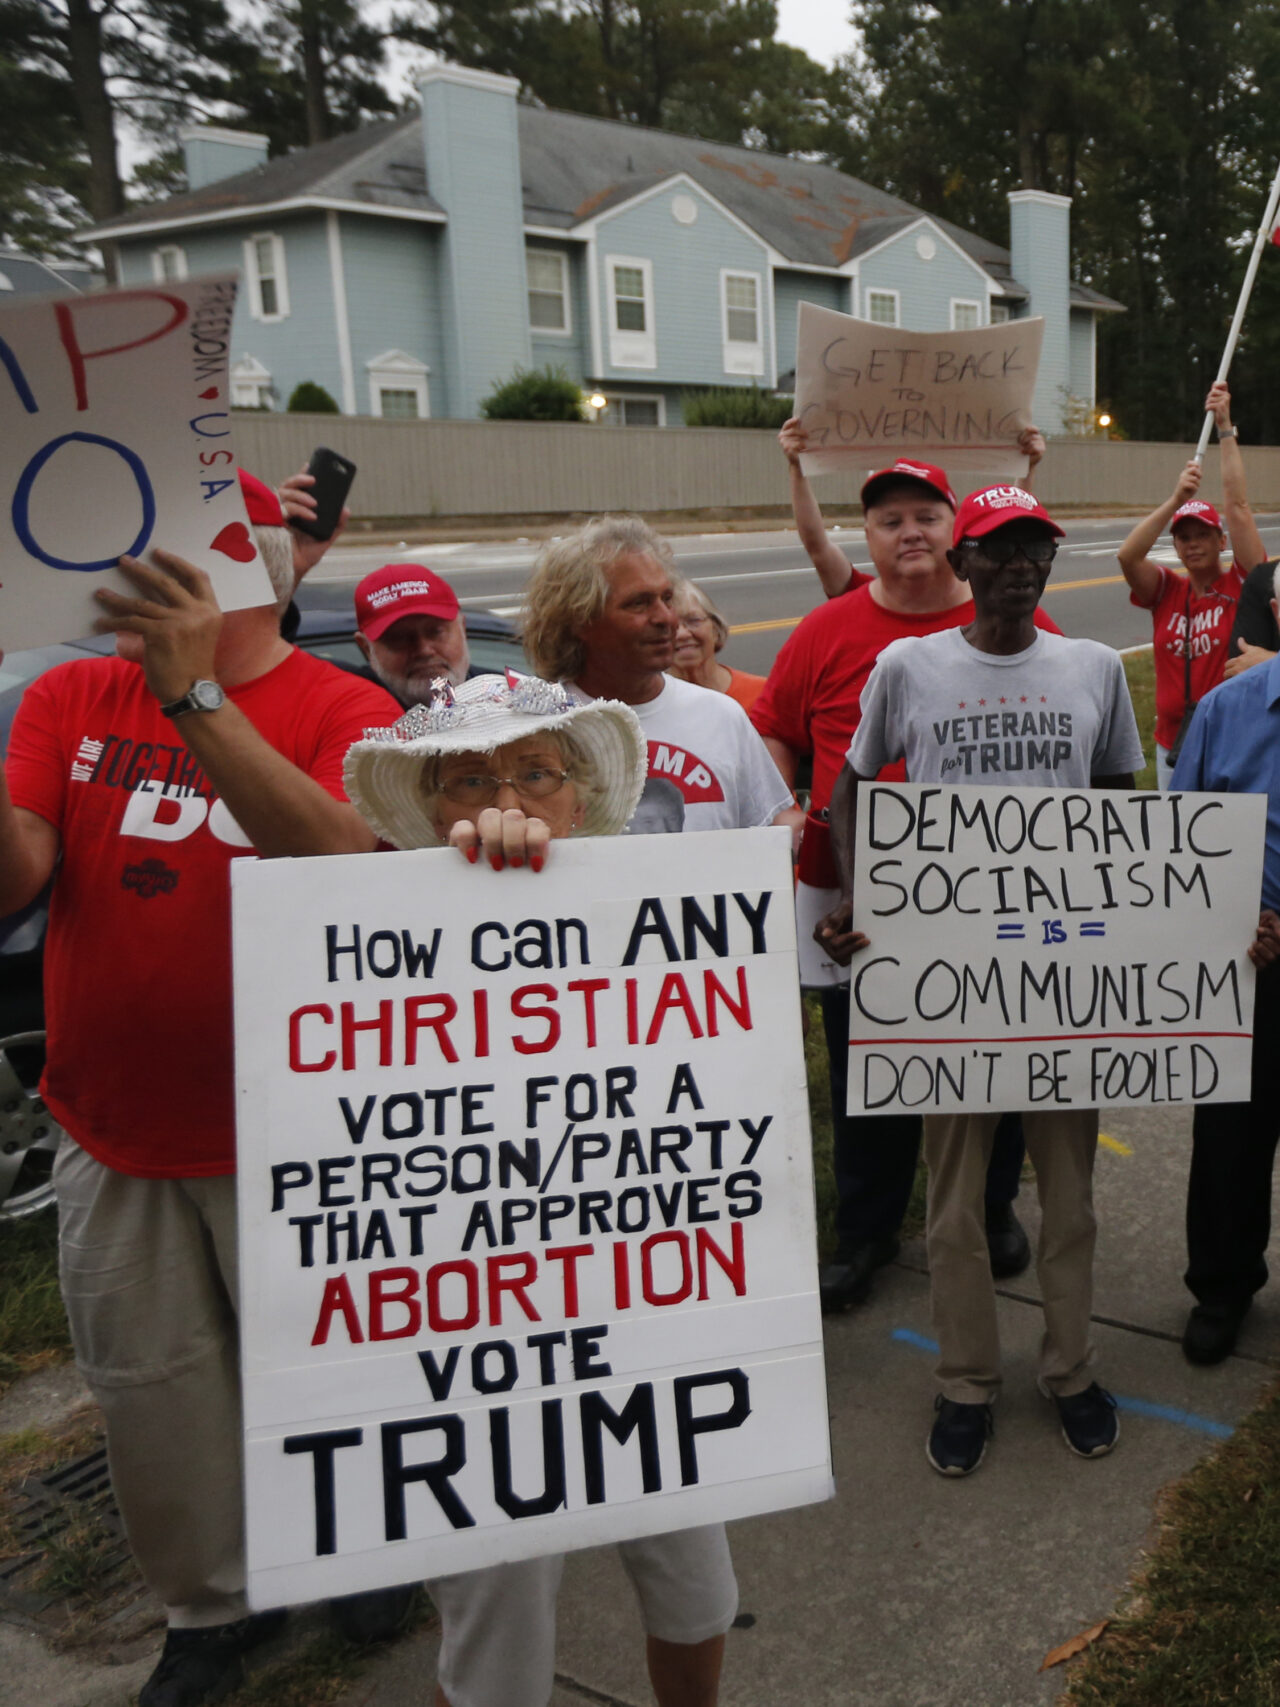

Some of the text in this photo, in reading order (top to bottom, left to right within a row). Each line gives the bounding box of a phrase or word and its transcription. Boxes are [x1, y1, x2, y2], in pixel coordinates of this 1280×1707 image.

[822, 337, 1025, 387] GET BACK
[892, 387, 926, 401] TO
[799, 402, 1024, 445] GOVERNING
[70, 736, 105, 782] WE ARE
[933, 711, 1073, 746] VETERANS
[940, 740, 1072, 778] for TRUMP
[89, 734, 216, 799] TOGETHE
[868, 787, 1233, 858] DEMOCRATIC
[869, 859, 1212, 917] SOCIALISM
[621, 891, 773, 967] ANY
[1042, 920, 1068, 945] IS
[288, 965, 754, 1074] CHRISTIAN
[854, 956, 1243, 1029] COMMUNISM
[337, 1062, 705, 1145] VOTE FOR A
[864, 1043, 1220, 1110] DON'T BE FOOLED
[270, 1115, 774, 1213] PERSON/PARTY
[289, 1169, 763, 1268] THAT APPROVES
[310, 1221, 747, 1347] ABORTION
[417, 1324, 614, 1402] VOTE
[283, 1367, 753, 1557] TRUMP
